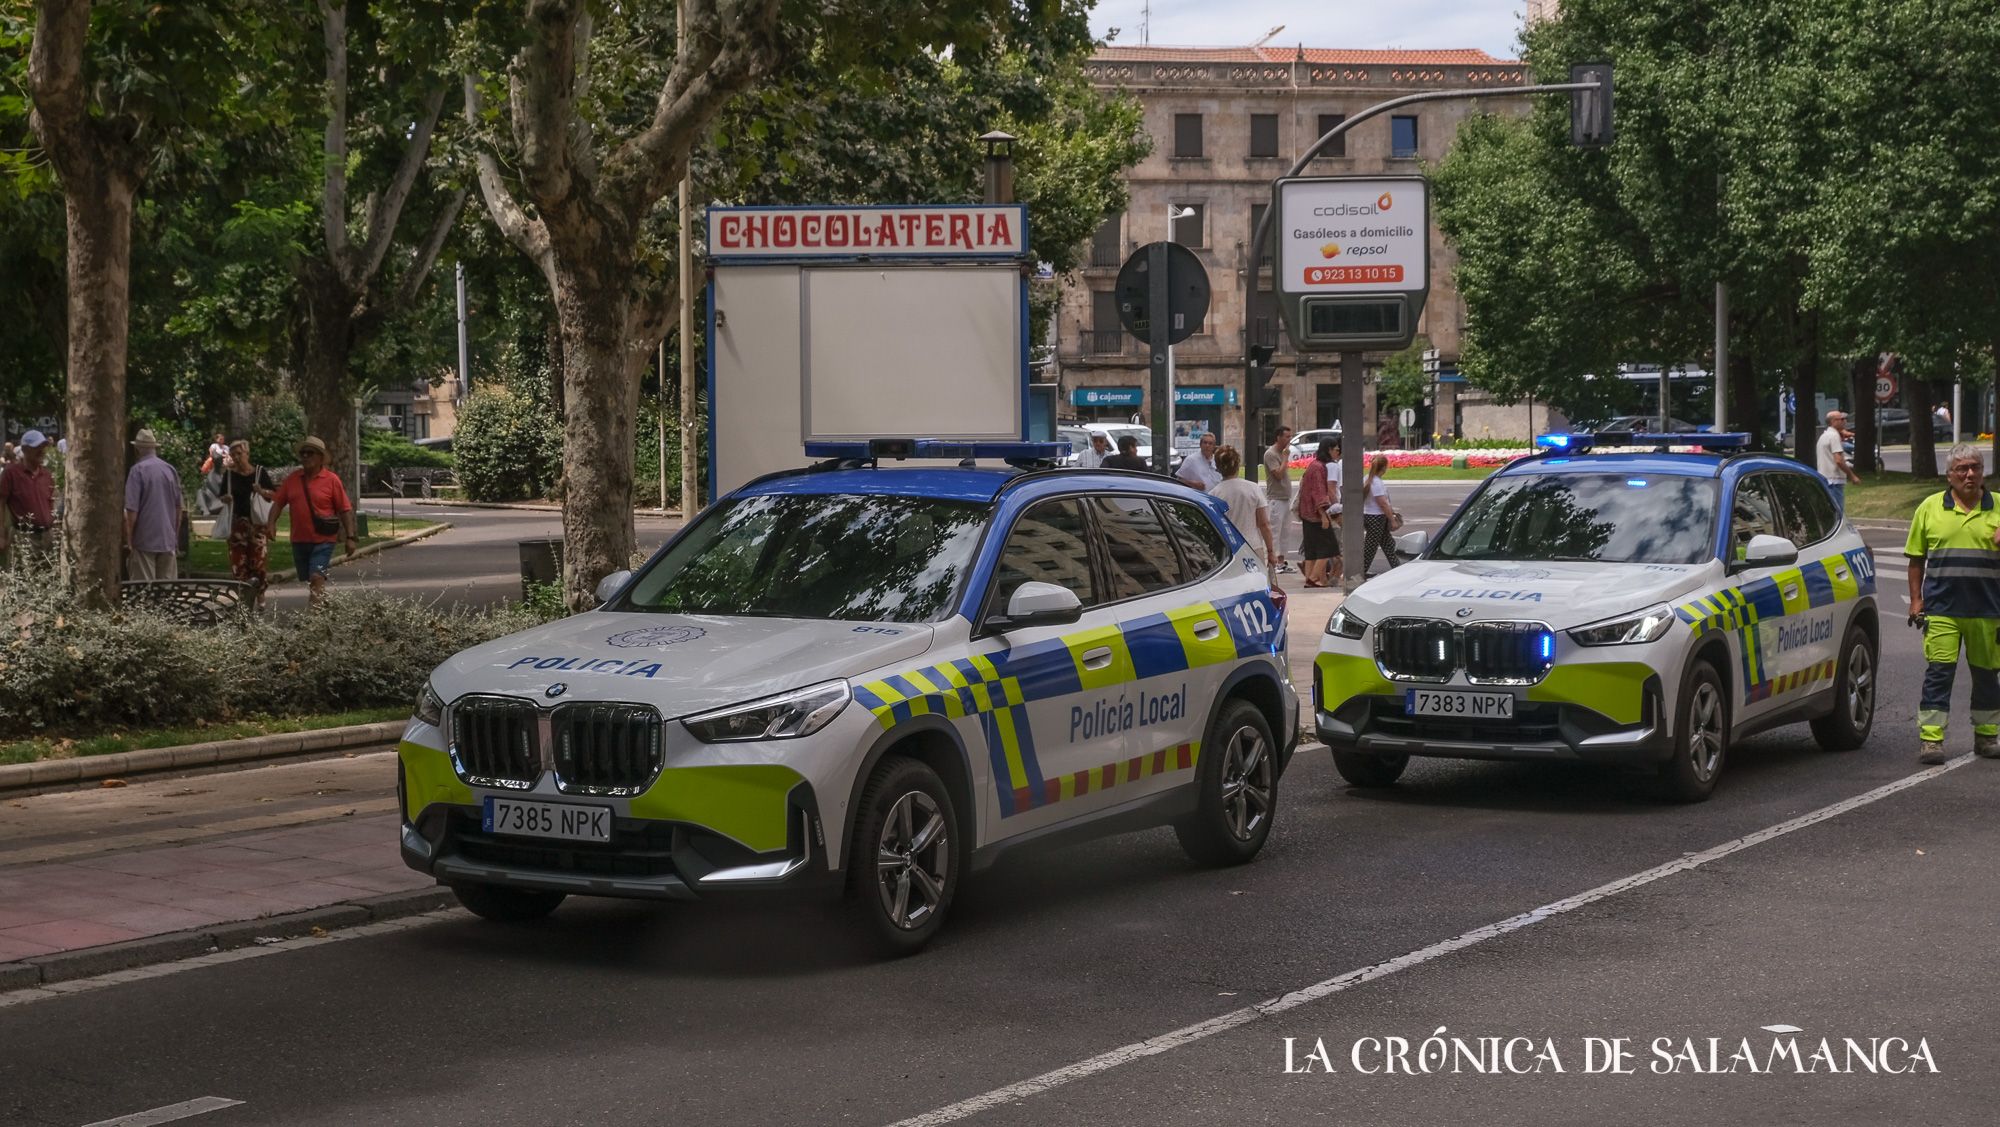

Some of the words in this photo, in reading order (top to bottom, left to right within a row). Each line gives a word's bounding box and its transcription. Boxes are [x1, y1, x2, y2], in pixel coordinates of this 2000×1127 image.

[1313, 202, 1379, 216] codisoil
[720, 213, 1012, 249] CHOCOLATERIA
[1293, 228, 1347, 239] Gasóleos
[1350, 230, 1357, 238] a
[1360, 226, 1413, 238] domicilio
[1346, 244, 1388, 257] repsol
[1324, 269, 1345, 280] 923
[1350, 269, 1362, 279] 13
[1366, 268, 1379, 279] 10
[1383, 267, 1396, 278] 15
[1876, 383, 1890, 392] 30
[1099, 392, 1132, 402] cajamar
[1183, 392, 1215, 402] cajamar
[1852, 551, 1874, 579] 112
[1420, 588, 1543, 602] POLICÍA
[1233, 599, 1274, 636] 112
[852, 626, 903, 636] 815
[1777, 618, 1808, 653] Policía
[1810, 612, 1834, 643] Local
[507, 656, 662, 678] POLICÍA
[1420, 694, 1465, 713] 7383
[1472, 696, 1508, 716] NPK
[1070, 694, 1133, 743] Policía
[1139, 683, 1186, 727] Local
[498, 804, 553, 833] 7385
[561, 809, 604, 837] NPK
